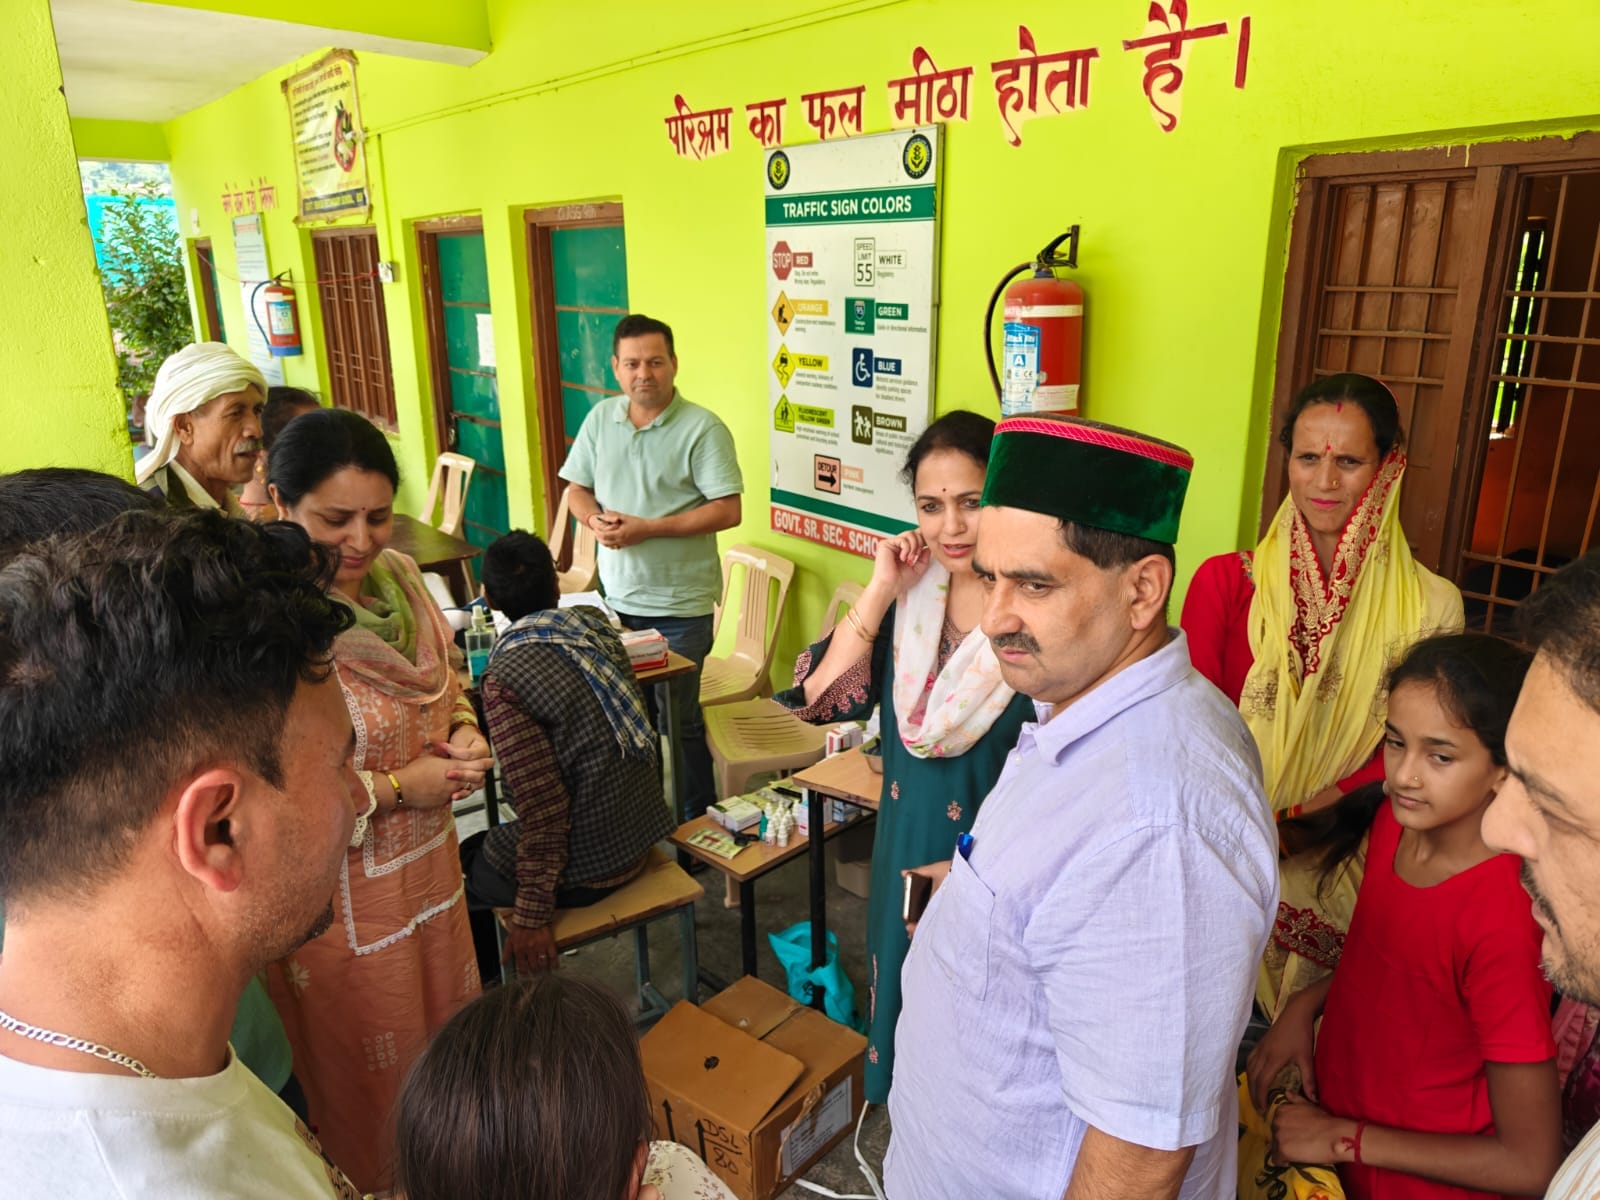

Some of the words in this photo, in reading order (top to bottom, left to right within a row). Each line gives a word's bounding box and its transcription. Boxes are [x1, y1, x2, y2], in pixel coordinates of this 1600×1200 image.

[664, 94, 734, 160] परिश्रम
[745, 98, 787, 147] का
[801, 85, 866, 141] फल
[888, 46, 974, 129] मीठा
[991, 25, 1099, 147] होता
[783, 200, 828, 218] TRAFFIC
[831, 198, 858, 216] SIGN
[861, 195, 912, 214] COLORS
[856, 242, 873, 250] SPEED
[772, 252, 792, 269] STOP
[795, 255, 809, 265] RED
[857, 252, 872, 261] LIMIT
[878, 254, 902, 265] WHITE
[856, 263, 873, 282] 55
[878, 306, 902, 317] GREEN
[798, 357, 823, 369] YELLOW
[877, 360, 896, 373] BLUE
[1014, 355, 1025, 366] A
[876, 416, 903, 429] BROWN
[817, 461, 838, 474] DETOUR
[774, 510, 802, 533] GOVT.
[804, 518, 821, 540] SR.
[822, 523, 846, 548] SEC.
